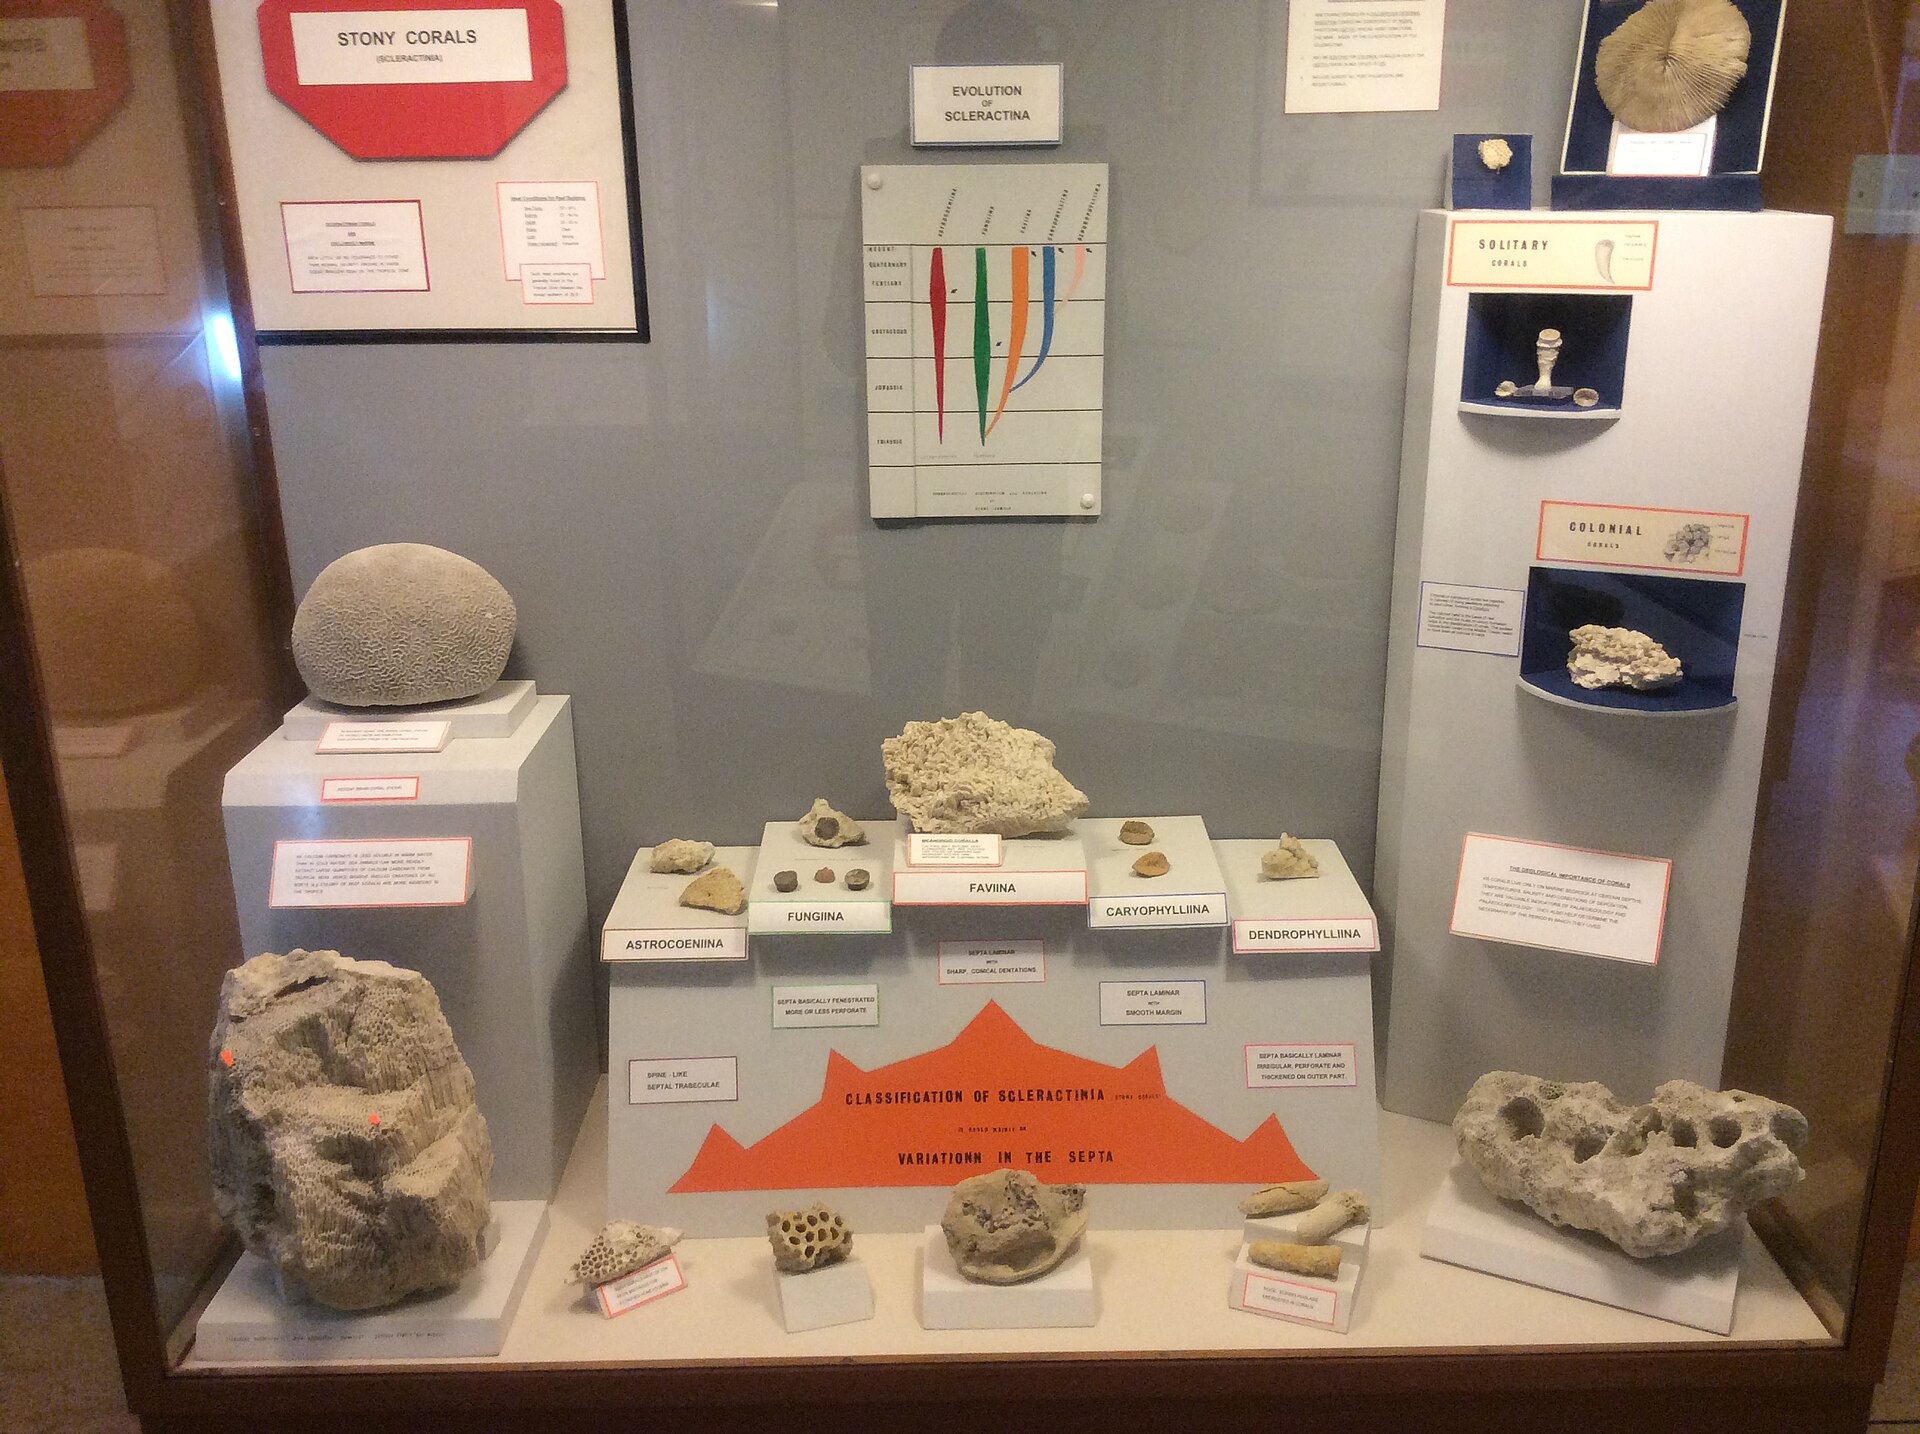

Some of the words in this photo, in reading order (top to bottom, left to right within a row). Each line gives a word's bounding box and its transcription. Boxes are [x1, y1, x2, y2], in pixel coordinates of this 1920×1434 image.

[338, 31, 395, 46] STONY
[406, 30, 477, 45] CORALS
[376, 54, 443, 64] (SCLERACTINIA)
[952, 86, 1022, 97] EVOLUTION
[945, 111, 1030, 122] SCLERACTINA
[1479, 239, 1549, 251] SOLITARY
[1491, 259, 1528, 268] CORALS
[1569, 521, 1643, 536] COLONIAL
[970, 882, 1016, 894] FAVIINA
[787, 911, 844, 923] FUNGIINA
[1106, 905, 1210, 917] CARYOPHYLLIINA
[1249, 928, 1361, 941] DENDROPHYLLIINA
[625, 938, 724, 950] ASTROCOENIINA
[831, 996, 875, 1004] FENESTRATED
[846, 1090, 963, 1105] CLASSIFICATION
[973, 1090, 990, 1103] OF
[998, 1088, 1105, 1103] SCLERACTINIA
[898, 1152, 982, 1165] VARIATIONN
[998, 1152, 1012, 1164] IN
[1026, 1151, 1052, 1164] THE
[1069, 1150, 1114, 1163] SEPTA
